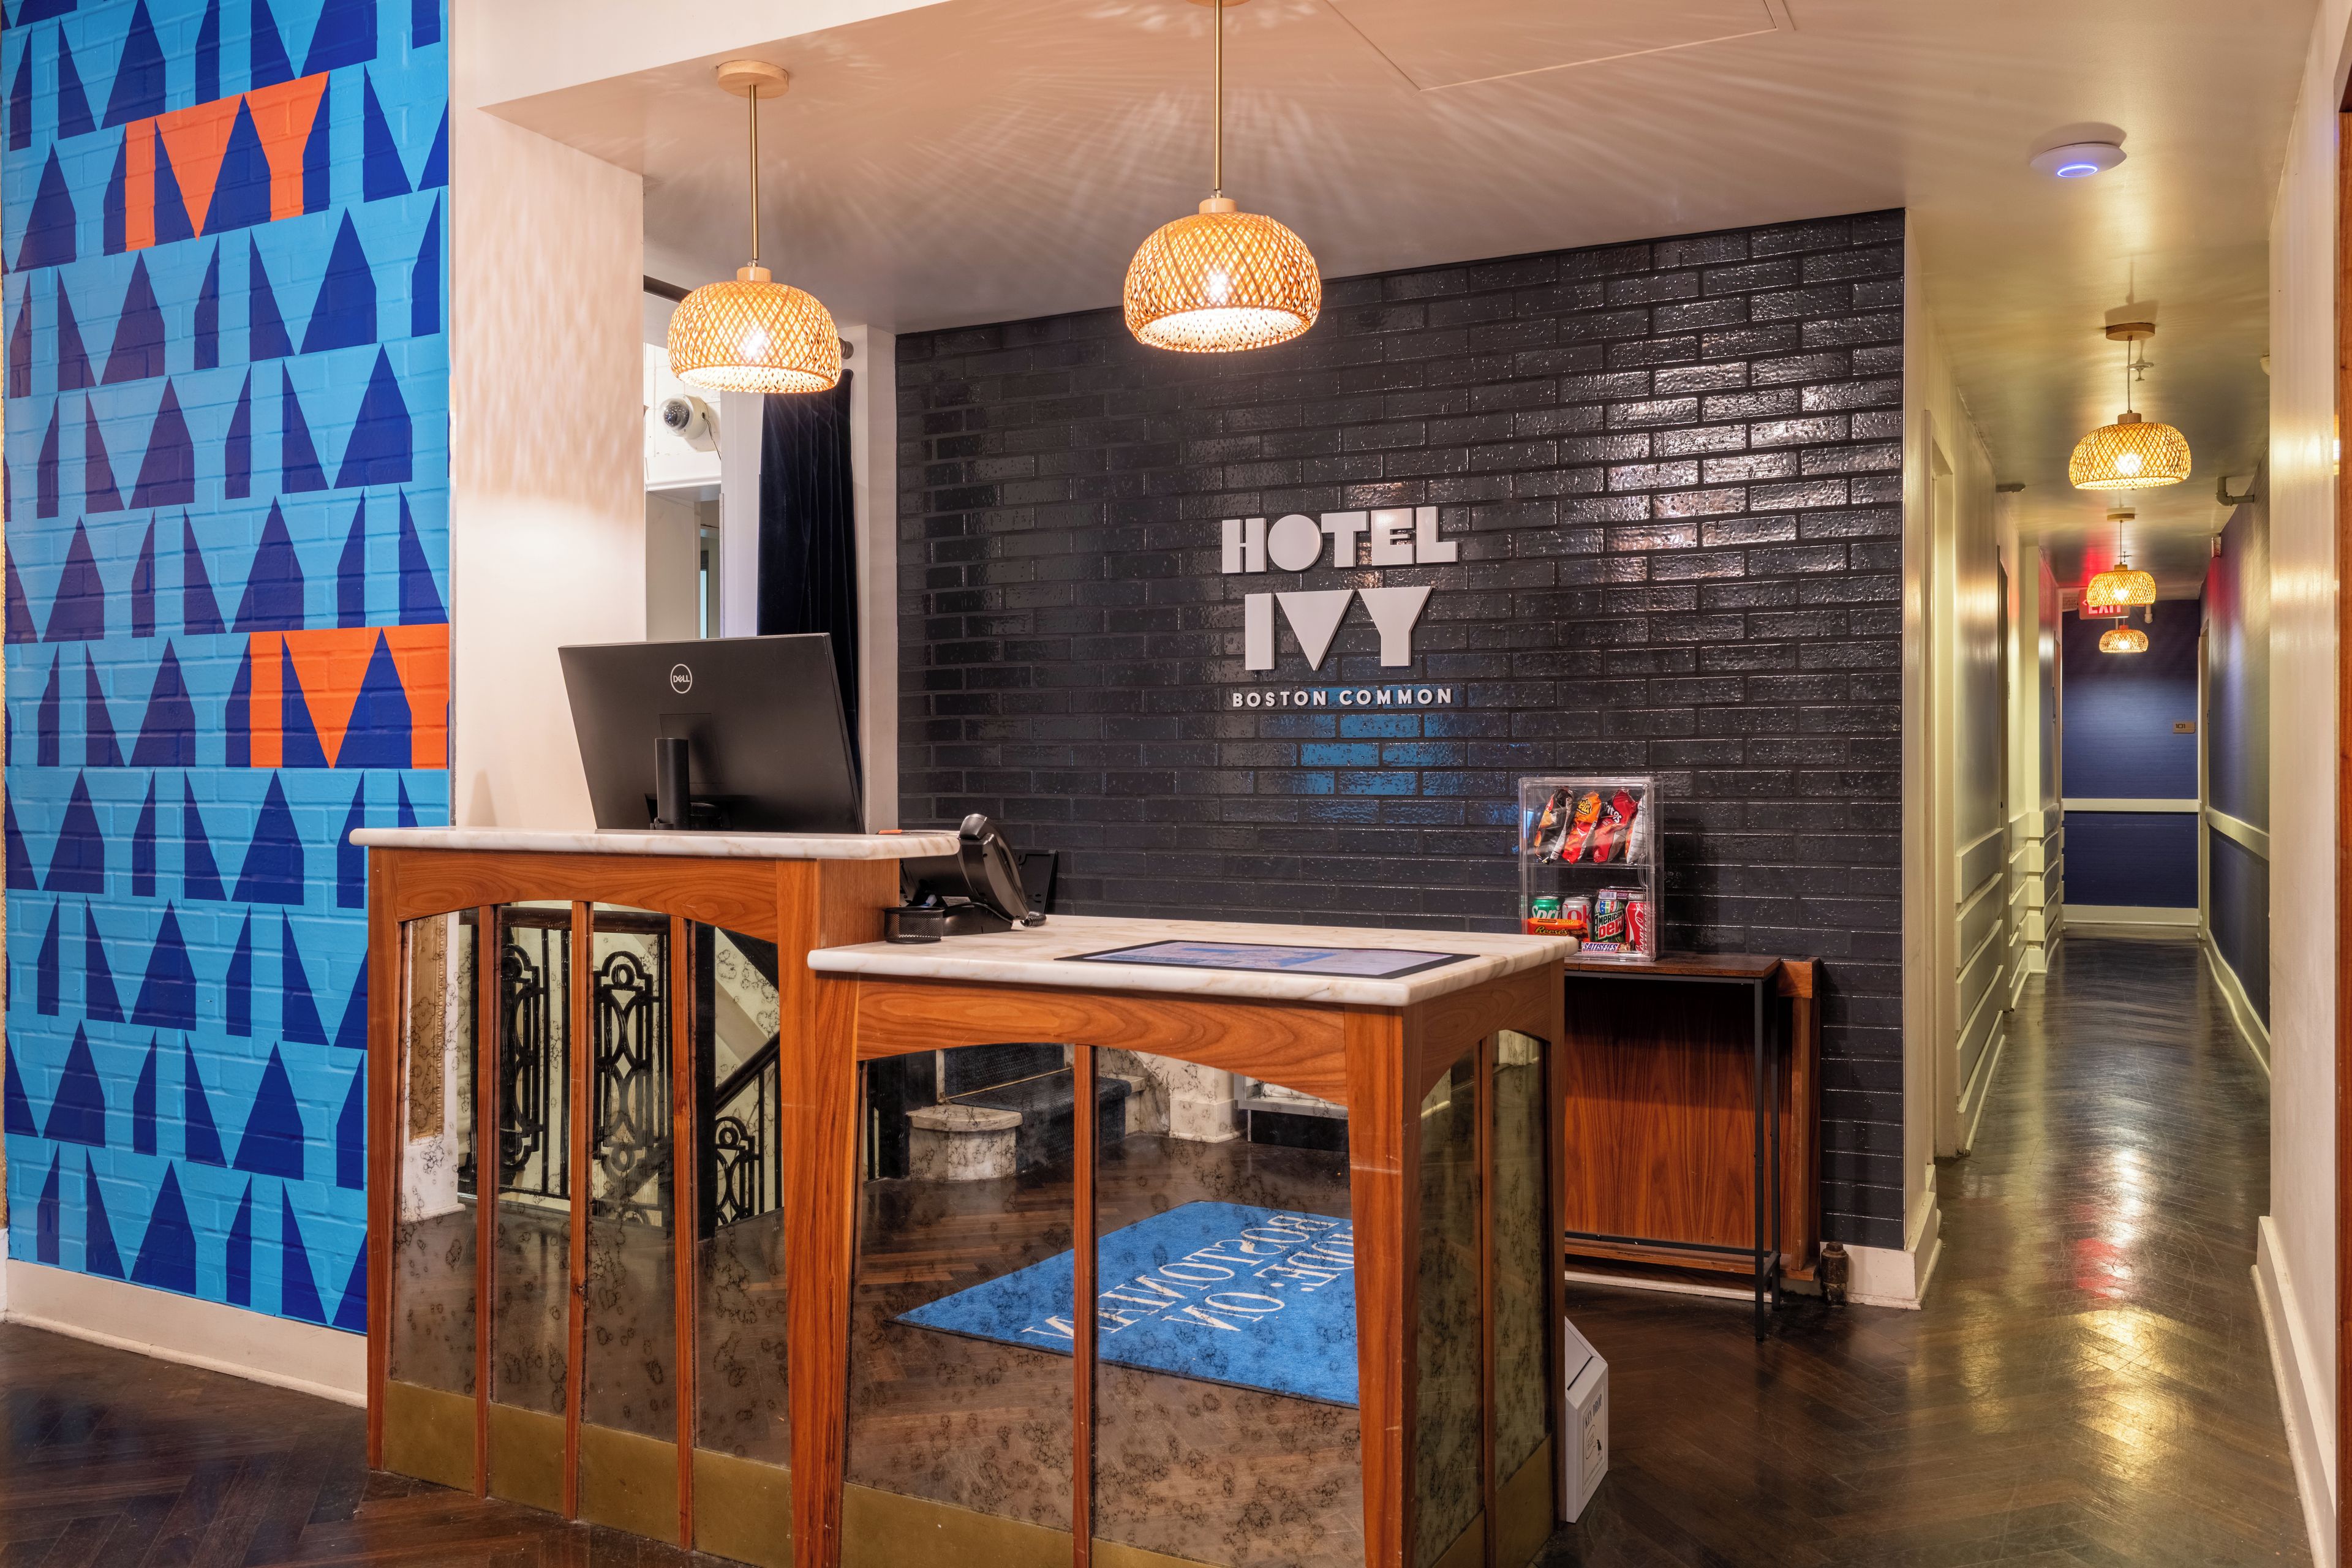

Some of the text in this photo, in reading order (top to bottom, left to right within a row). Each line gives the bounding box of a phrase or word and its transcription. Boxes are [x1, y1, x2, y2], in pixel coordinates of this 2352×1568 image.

[126, 71, 330, 252] IVY
[1222, 506, 1458, 573] HOTEL
[1245, 586, 1433, 671] IVY
[1232, 688, 1452, 707] BOSTON COMMON
[1582, 943, 1618, 952] SATISFIES
